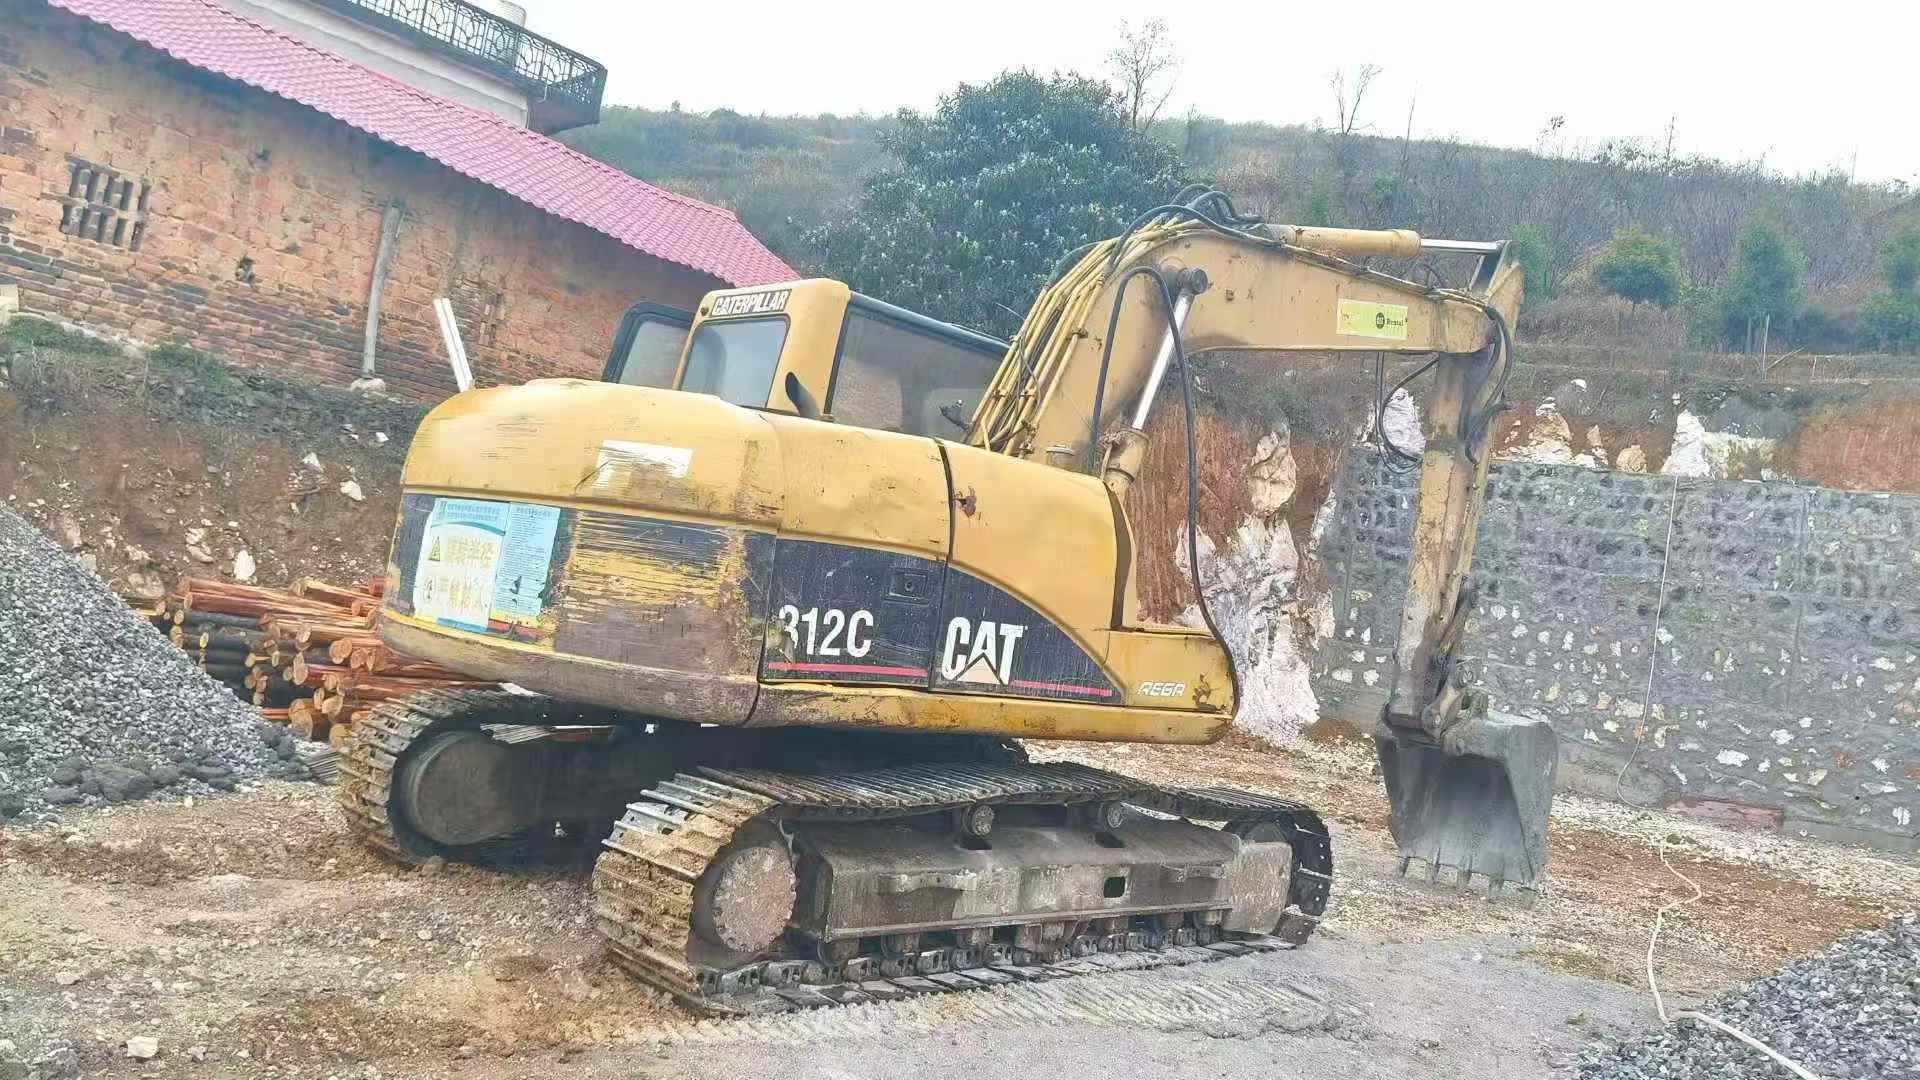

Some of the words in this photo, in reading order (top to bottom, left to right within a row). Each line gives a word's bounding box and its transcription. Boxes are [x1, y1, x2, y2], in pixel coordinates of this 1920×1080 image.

[712, 290, 789, 317] CATERPILLAR
[778, 604, 874, 658] 312C
[941, 616, 1025, 686] CAT
